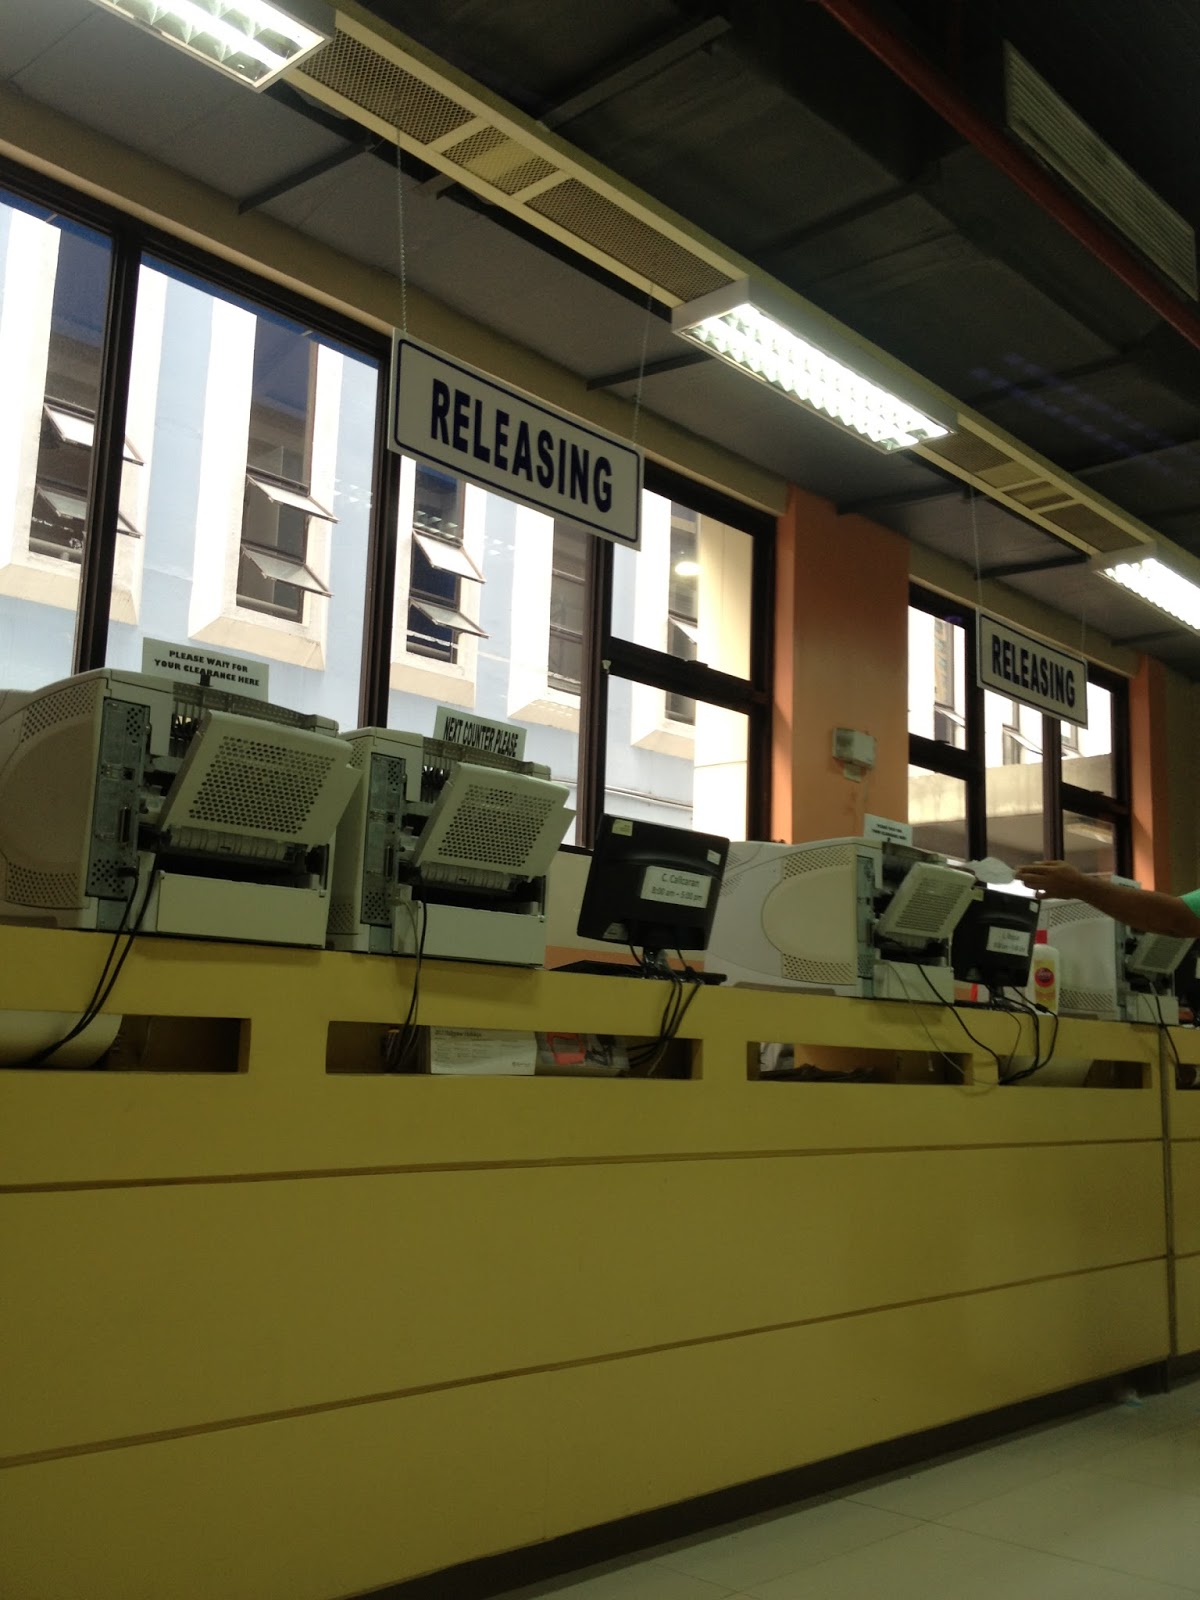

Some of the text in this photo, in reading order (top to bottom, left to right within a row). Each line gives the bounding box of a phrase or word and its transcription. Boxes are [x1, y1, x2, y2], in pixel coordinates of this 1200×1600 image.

[430, 378, 613, 514] RELEASING
[154, 659, 260, 686] YOUR CLEARANCE HERE
[169, 650, 248, 673] PLEASE WAIT FOR
[991, 634, 1076, 708] RELEASING
[443, 716, 519, 758] NEXT COUNTER PLEASE
